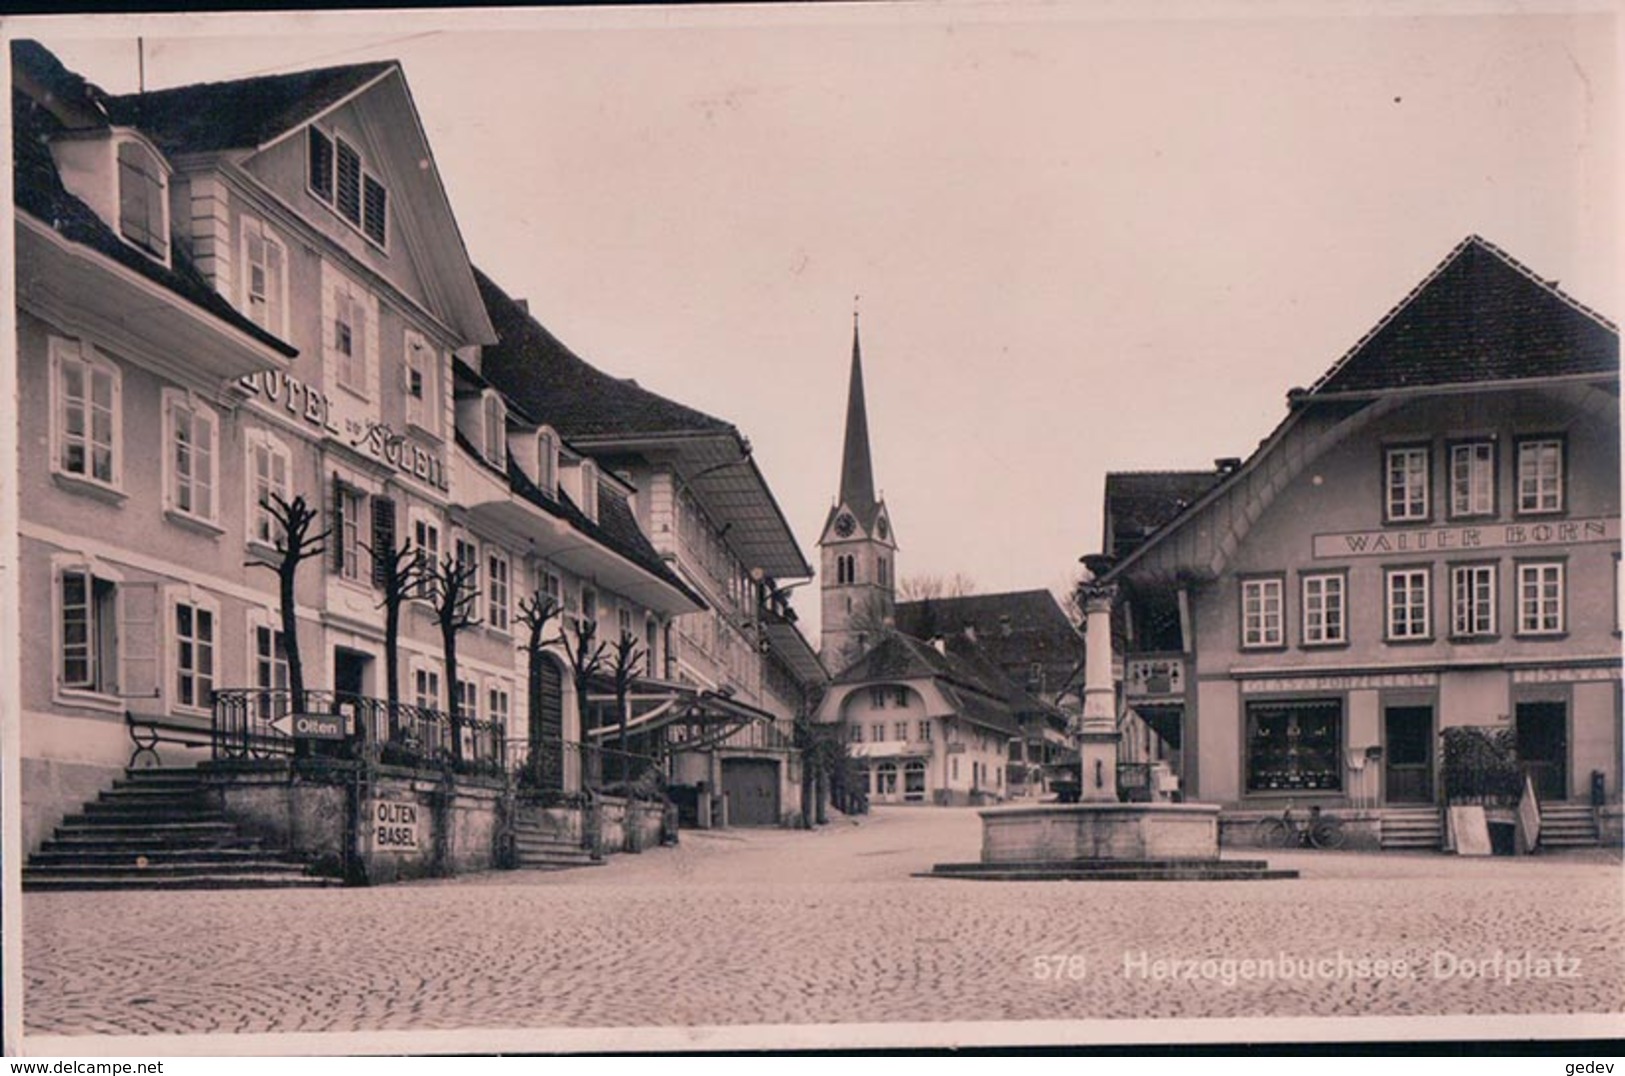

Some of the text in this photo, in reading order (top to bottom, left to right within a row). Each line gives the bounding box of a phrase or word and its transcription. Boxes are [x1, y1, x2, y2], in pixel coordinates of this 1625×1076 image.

[367, 424, 449, 492] SOLEIL
[1505, 521, 1606, 544] BORN
[297, 719, 337, 734] Olten
[377, 803, 416, 824] OLTEN
[377, 826, 416, 847] BASEL
